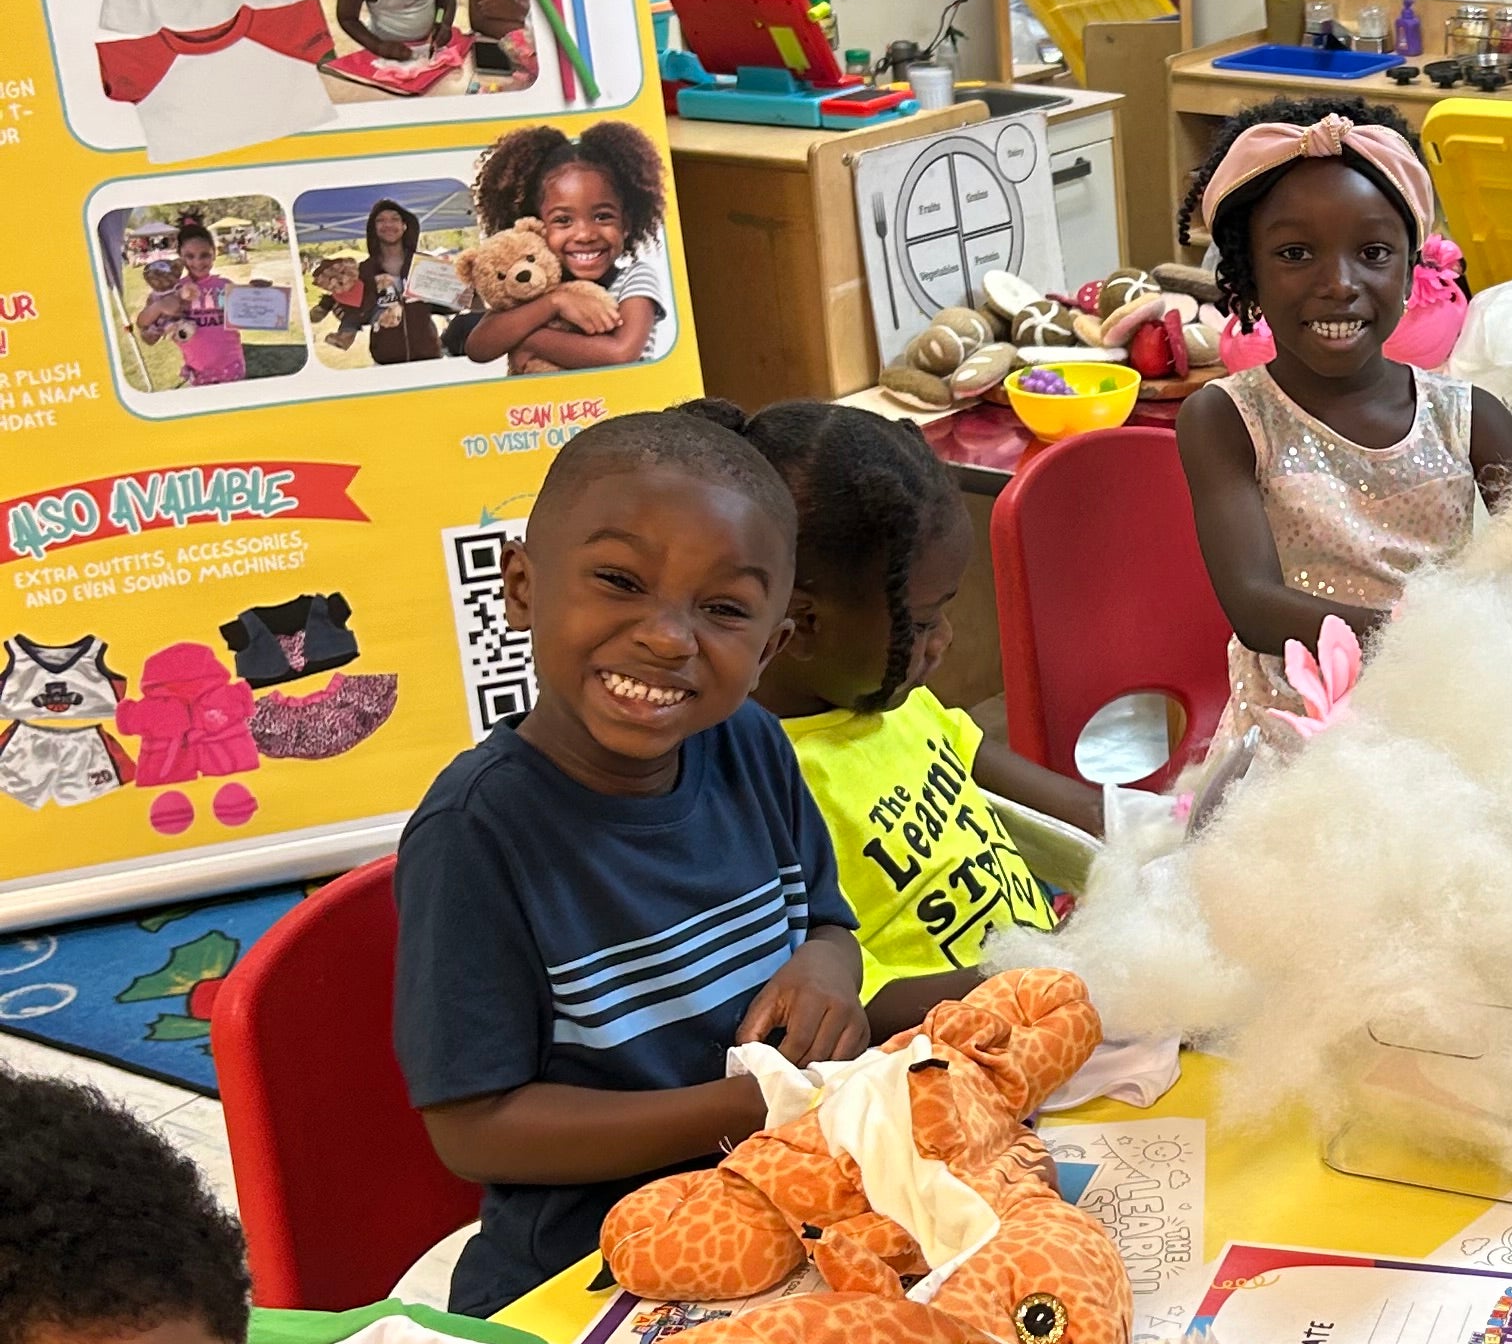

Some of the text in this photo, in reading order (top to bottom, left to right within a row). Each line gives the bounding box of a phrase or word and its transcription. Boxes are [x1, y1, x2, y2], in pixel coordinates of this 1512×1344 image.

[919, 203, 941, 215] Fruits
[15, 360, 81, 387] PLUSH
[22, 391, 34, 408] A
[39, 382, 100, 405] NAME
[508, 399, 607, 428] SCAN HERE
[463, 436, 488, 456] TO
[493, 429, 540, 453] VISIT
[11, 468, 297, 558] ALSO AVAILABLE
[14, 530, 309, 589] EXTRA OUTFITS, ACCESSORIES,
[26, 552, 306, 608] AND EVEN SOUND MACHINES!
[863, 734, 967, 892] Learni
[869, 785, 911, 833] The
[1165, 1227, 1191, 1264] THE
